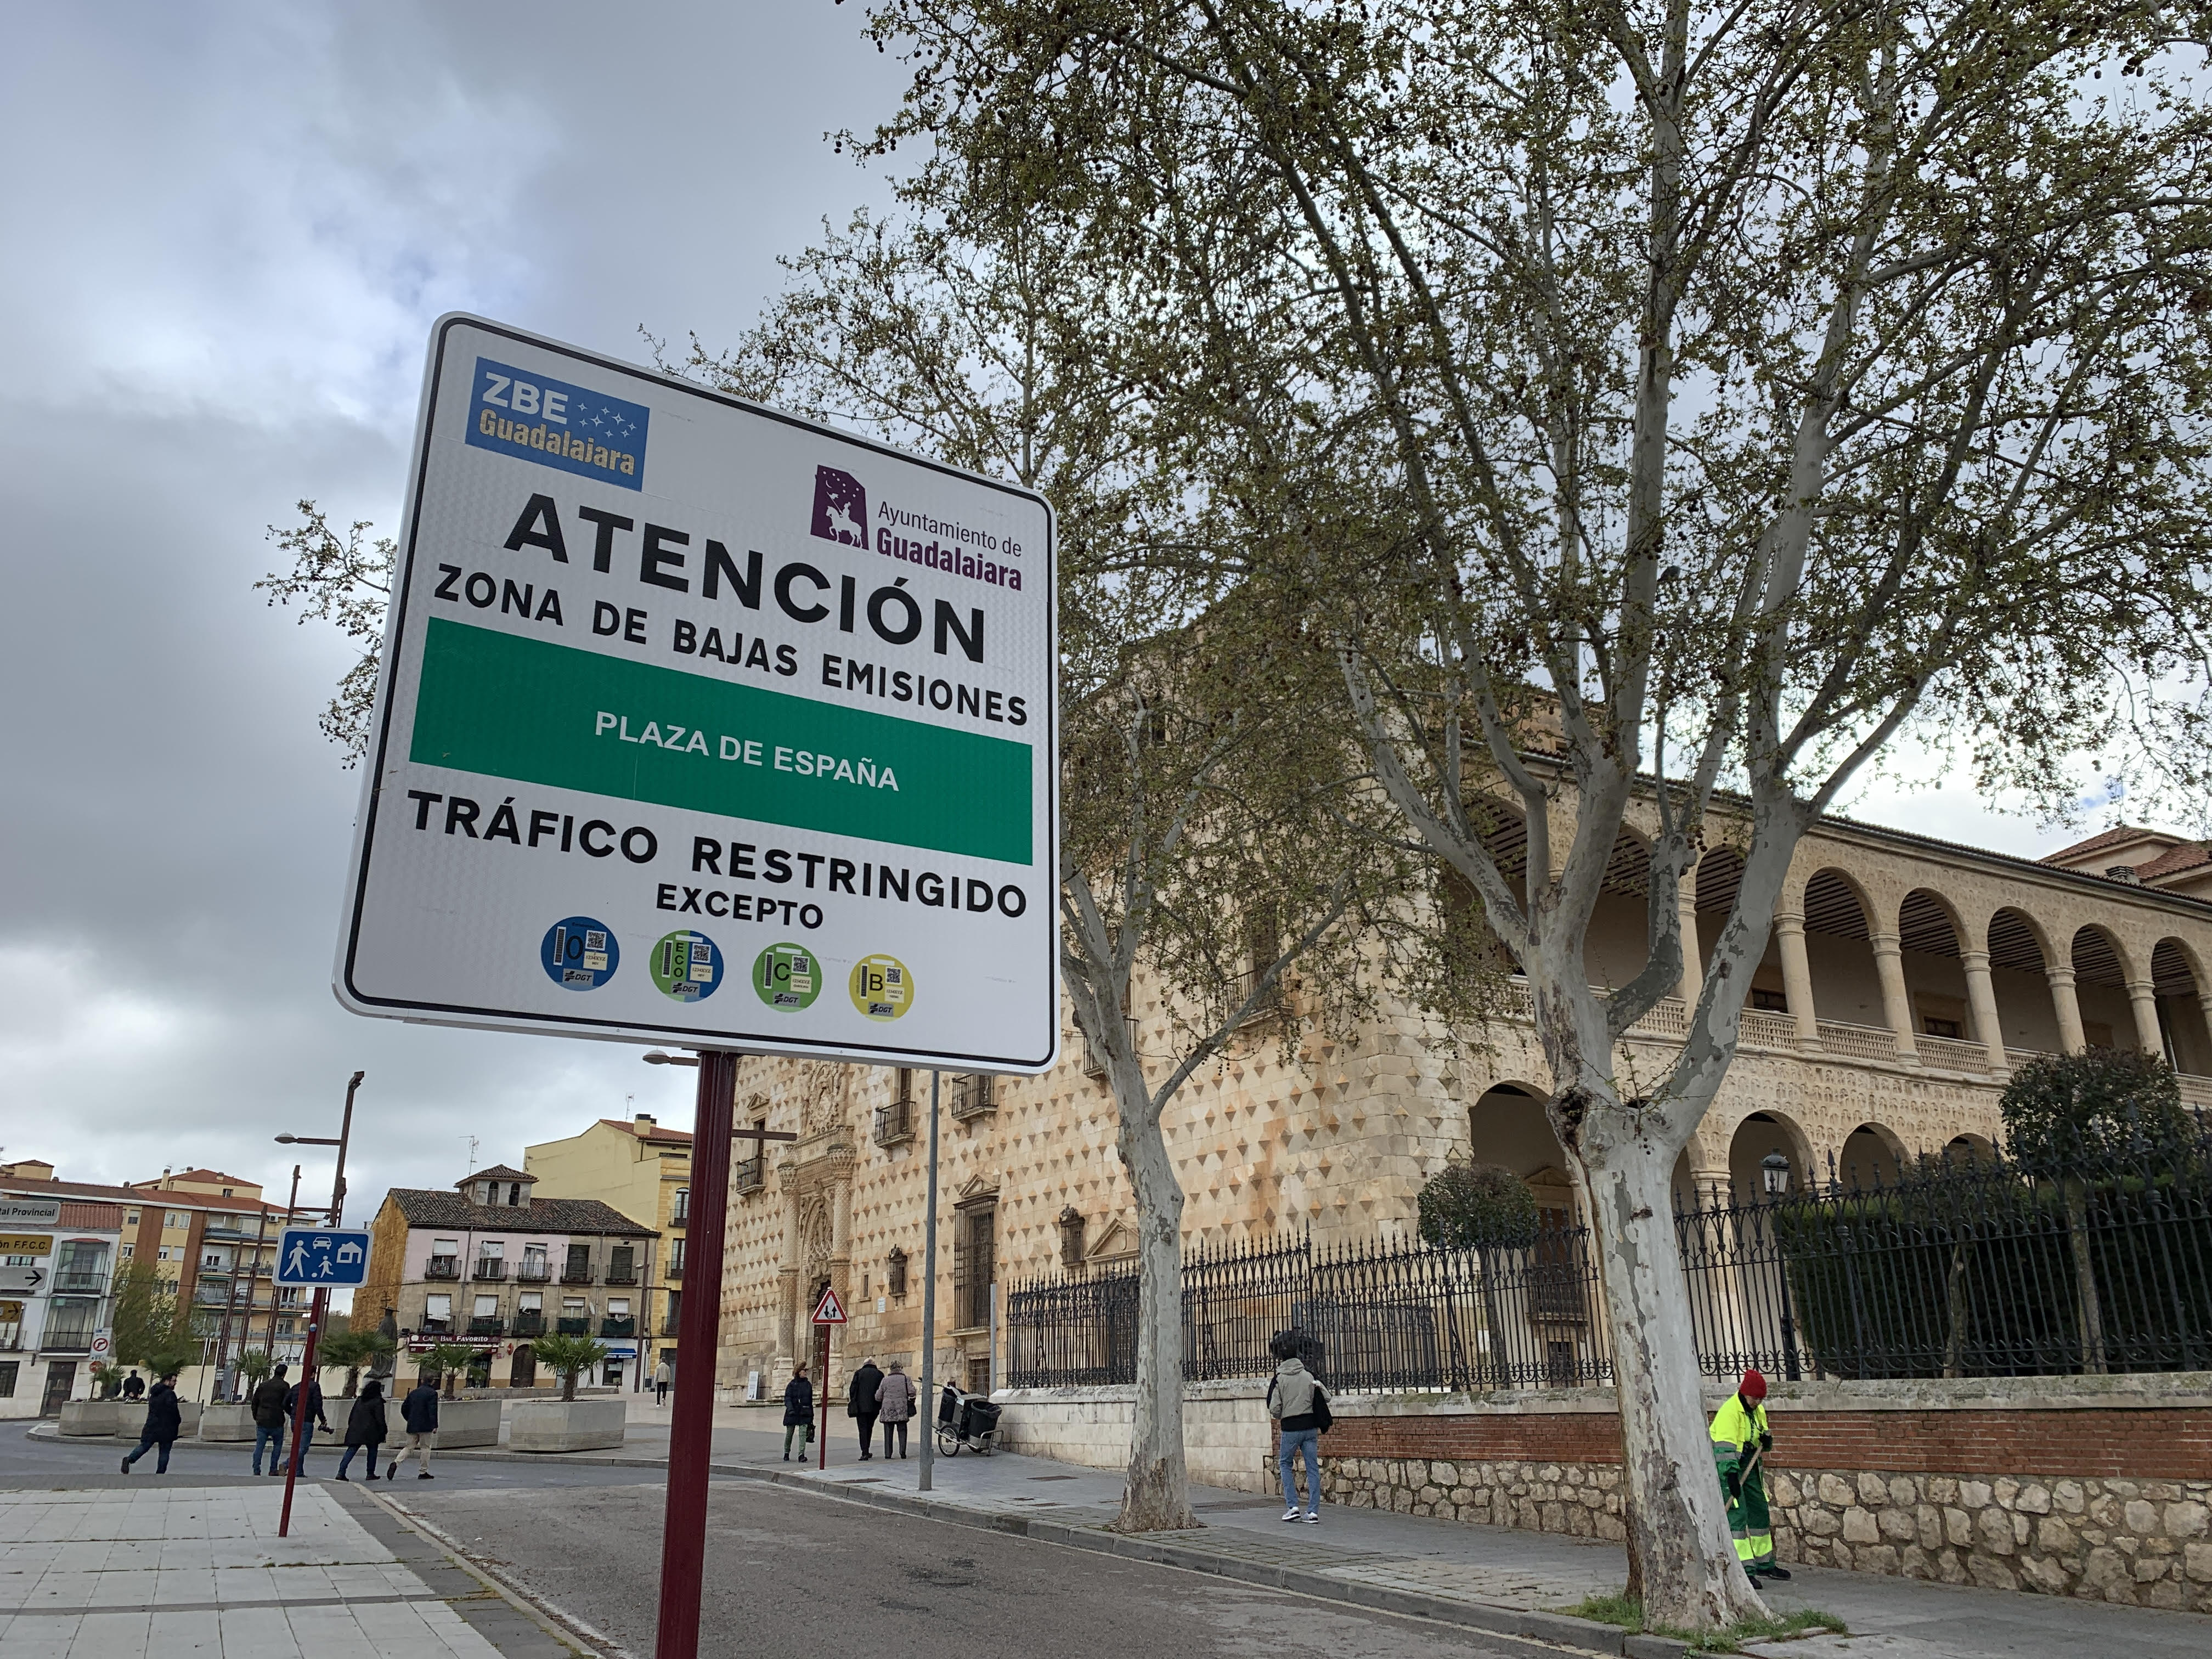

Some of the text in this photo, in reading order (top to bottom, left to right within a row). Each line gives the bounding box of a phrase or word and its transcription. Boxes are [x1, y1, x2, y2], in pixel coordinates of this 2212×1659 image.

[482, 371, 568, 425] ZBE
[479, 408, 635, 476] Guadalajara
[878, 501, 1022, 557] Ayuntamiento de
[503, 493, 984, 664] ATENCIÓN
[877, 527, 1022, 591] Guadalajara
[434, 563, 1028, 726] ZONA DE BAJAS EMISIONES
[595, 711, 900, 792] PLAZA DE ESPAÑA
[407, 789, 1027, 918] TRÁFICO RESTRINGIDO
[657, 883, 823, 930] EXCEPTO
[674, 943, 684, 978] ECO
[774, 962, 790, 981] C
[870, 973, 883, 991] B
[12, 1207, 55, 1216] Provincial
[14, 1240, 48, 1250] F.F.C.C.
